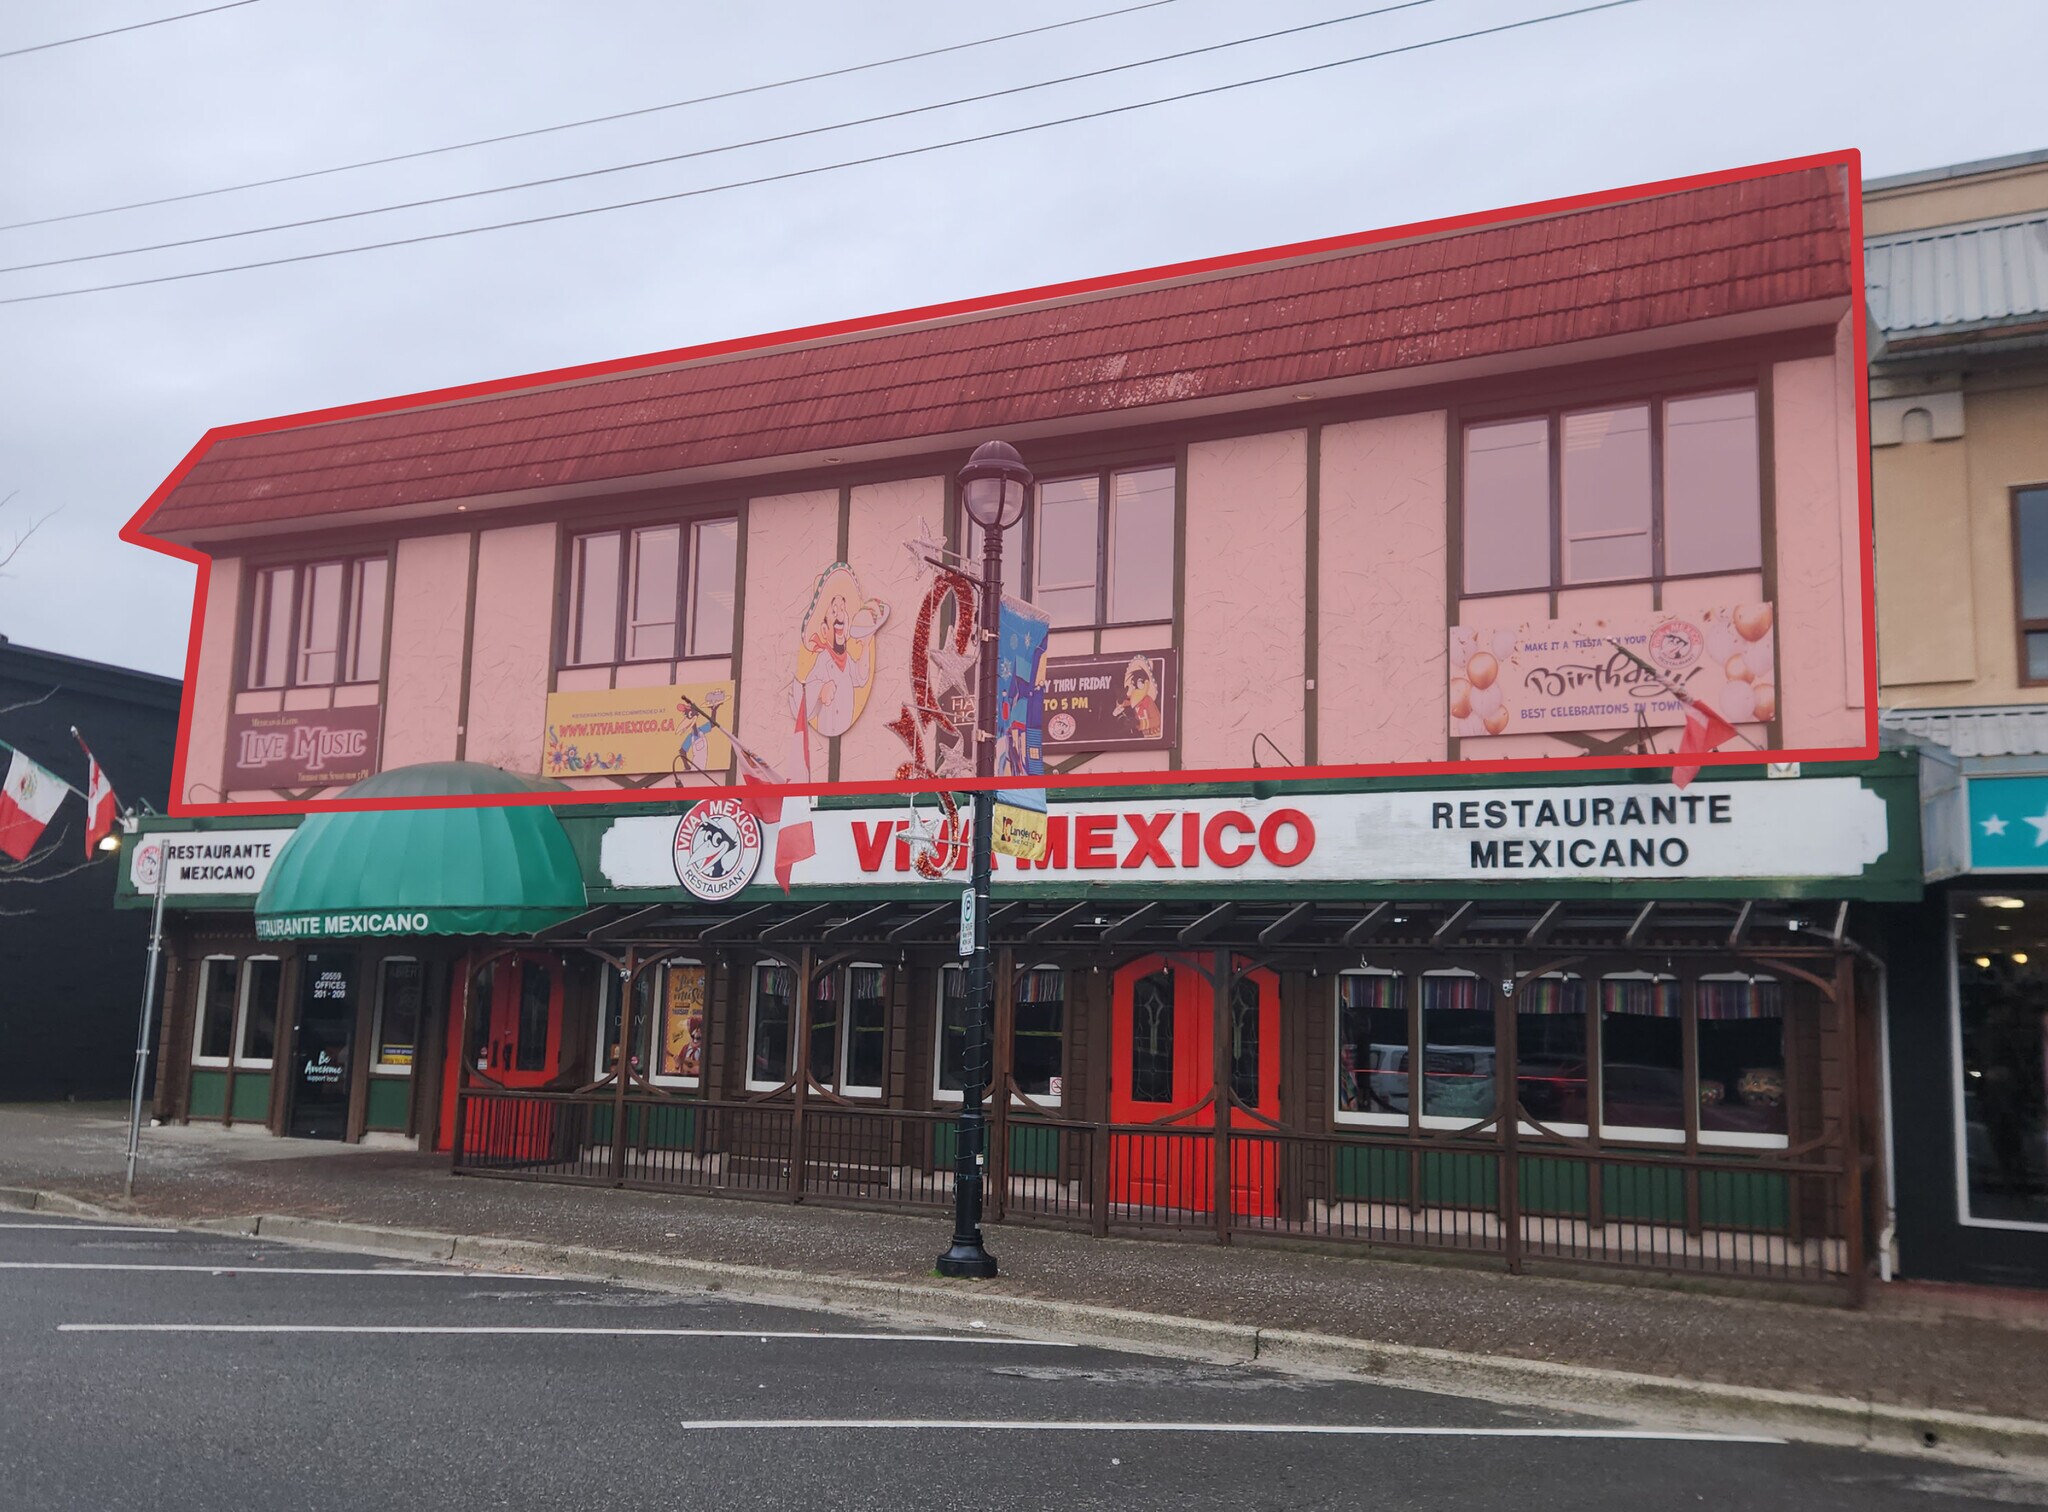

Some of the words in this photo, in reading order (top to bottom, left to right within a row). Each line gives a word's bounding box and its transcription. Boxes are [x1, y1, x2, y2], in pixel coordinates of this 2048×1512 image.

[1524, 642, 1548, 652] MAKE
[1550, 641, 1561, 651] IT
[1563, 641, 1569, 650] A
[1624, 634, 1647, 645] YOUR
[1053, 678, 1077, 693] THRU
[1079, 675, 1112, 691] FRIDAY
[1043, 698, 1058, 712] TO
[1061, 698, 1069, 711] 5
[1071, 696, 1089, 710] PM
[1520, 708, 1546, 719] BEST
[1550, 703, 1630, 718] CELEBRATIONS
[559, 718, 675, 738] WWW.VIVAMEXICO.CA
[1431, 793, 1733, 831] RESTAURANTE
[678, 814, 702, 849] VIVA
[709, 800, 757, 847] MEXICO
[168, 843, 272, 860] RESTAURANTE
[1469, 836, 1690, 870] MEXICANO
[180, 865, 255, 880] MEXICANO
[684, 867, 747, 894] RESTAURANT
[325, 913, 428, 934] MEXICANO
[313, 989, 327, 999] 201
[314, 980, 347, 990] OFFICES
